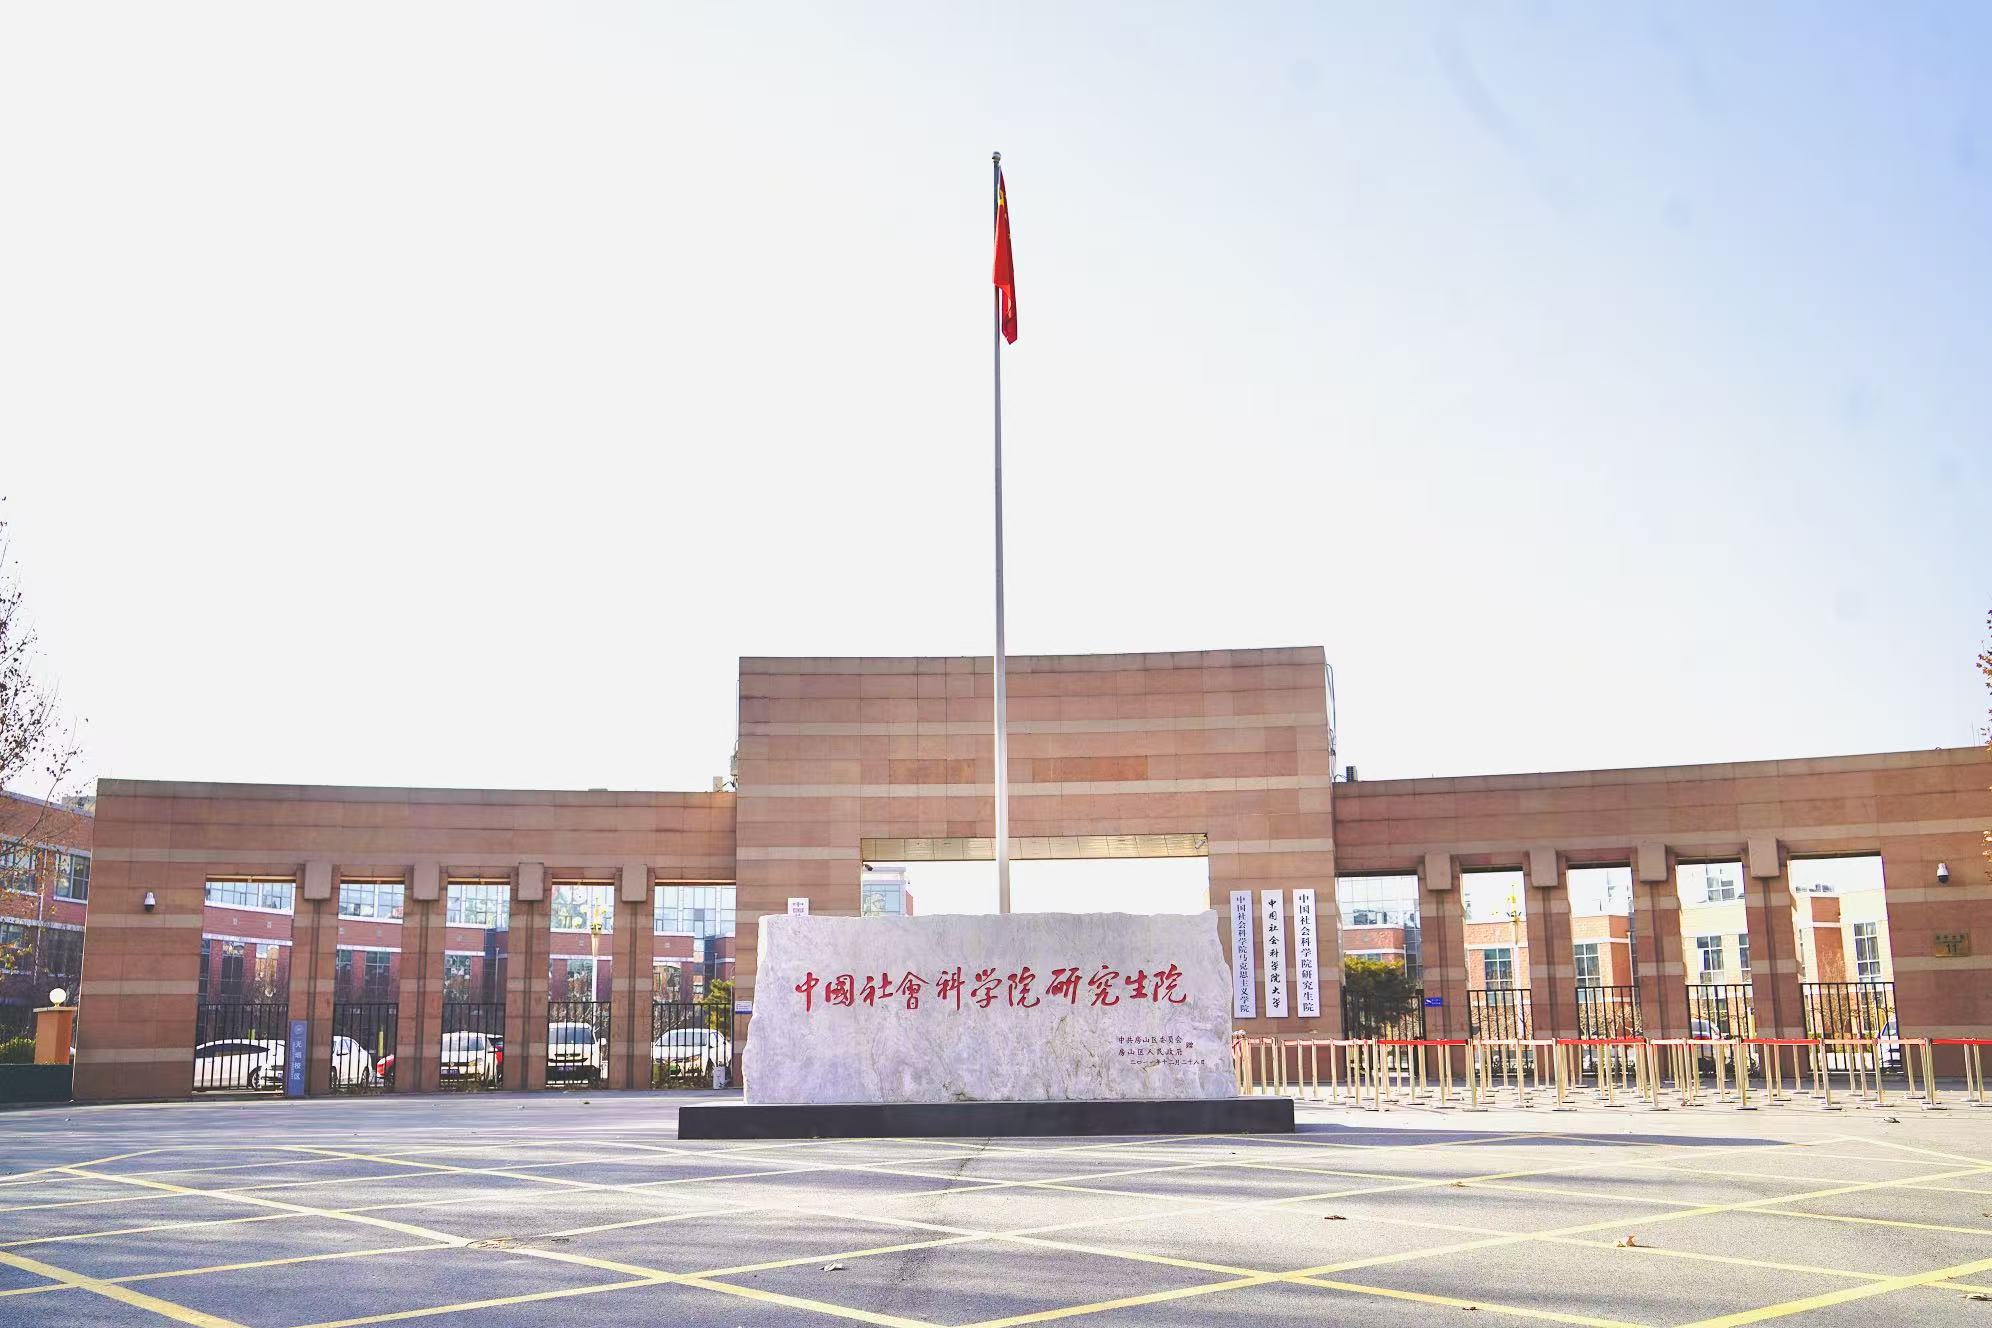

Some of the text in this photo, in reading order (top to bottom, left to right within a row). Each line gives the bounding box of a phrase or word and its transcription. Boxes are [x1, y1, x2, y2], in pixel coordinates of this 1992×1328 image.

[1236, 895, 1250, 1013] 中国社会科学院马克思主义学院
[1268, 899, 1281, 1009] 中国社会科学院大学
[1298, 893, 1315, 1012] 中国社会科学院研究生院
[1118, 1035, 1183, 1044] 中共房山区委员会
[1118, 1048, 1183, 1057] 房山区人民政府
